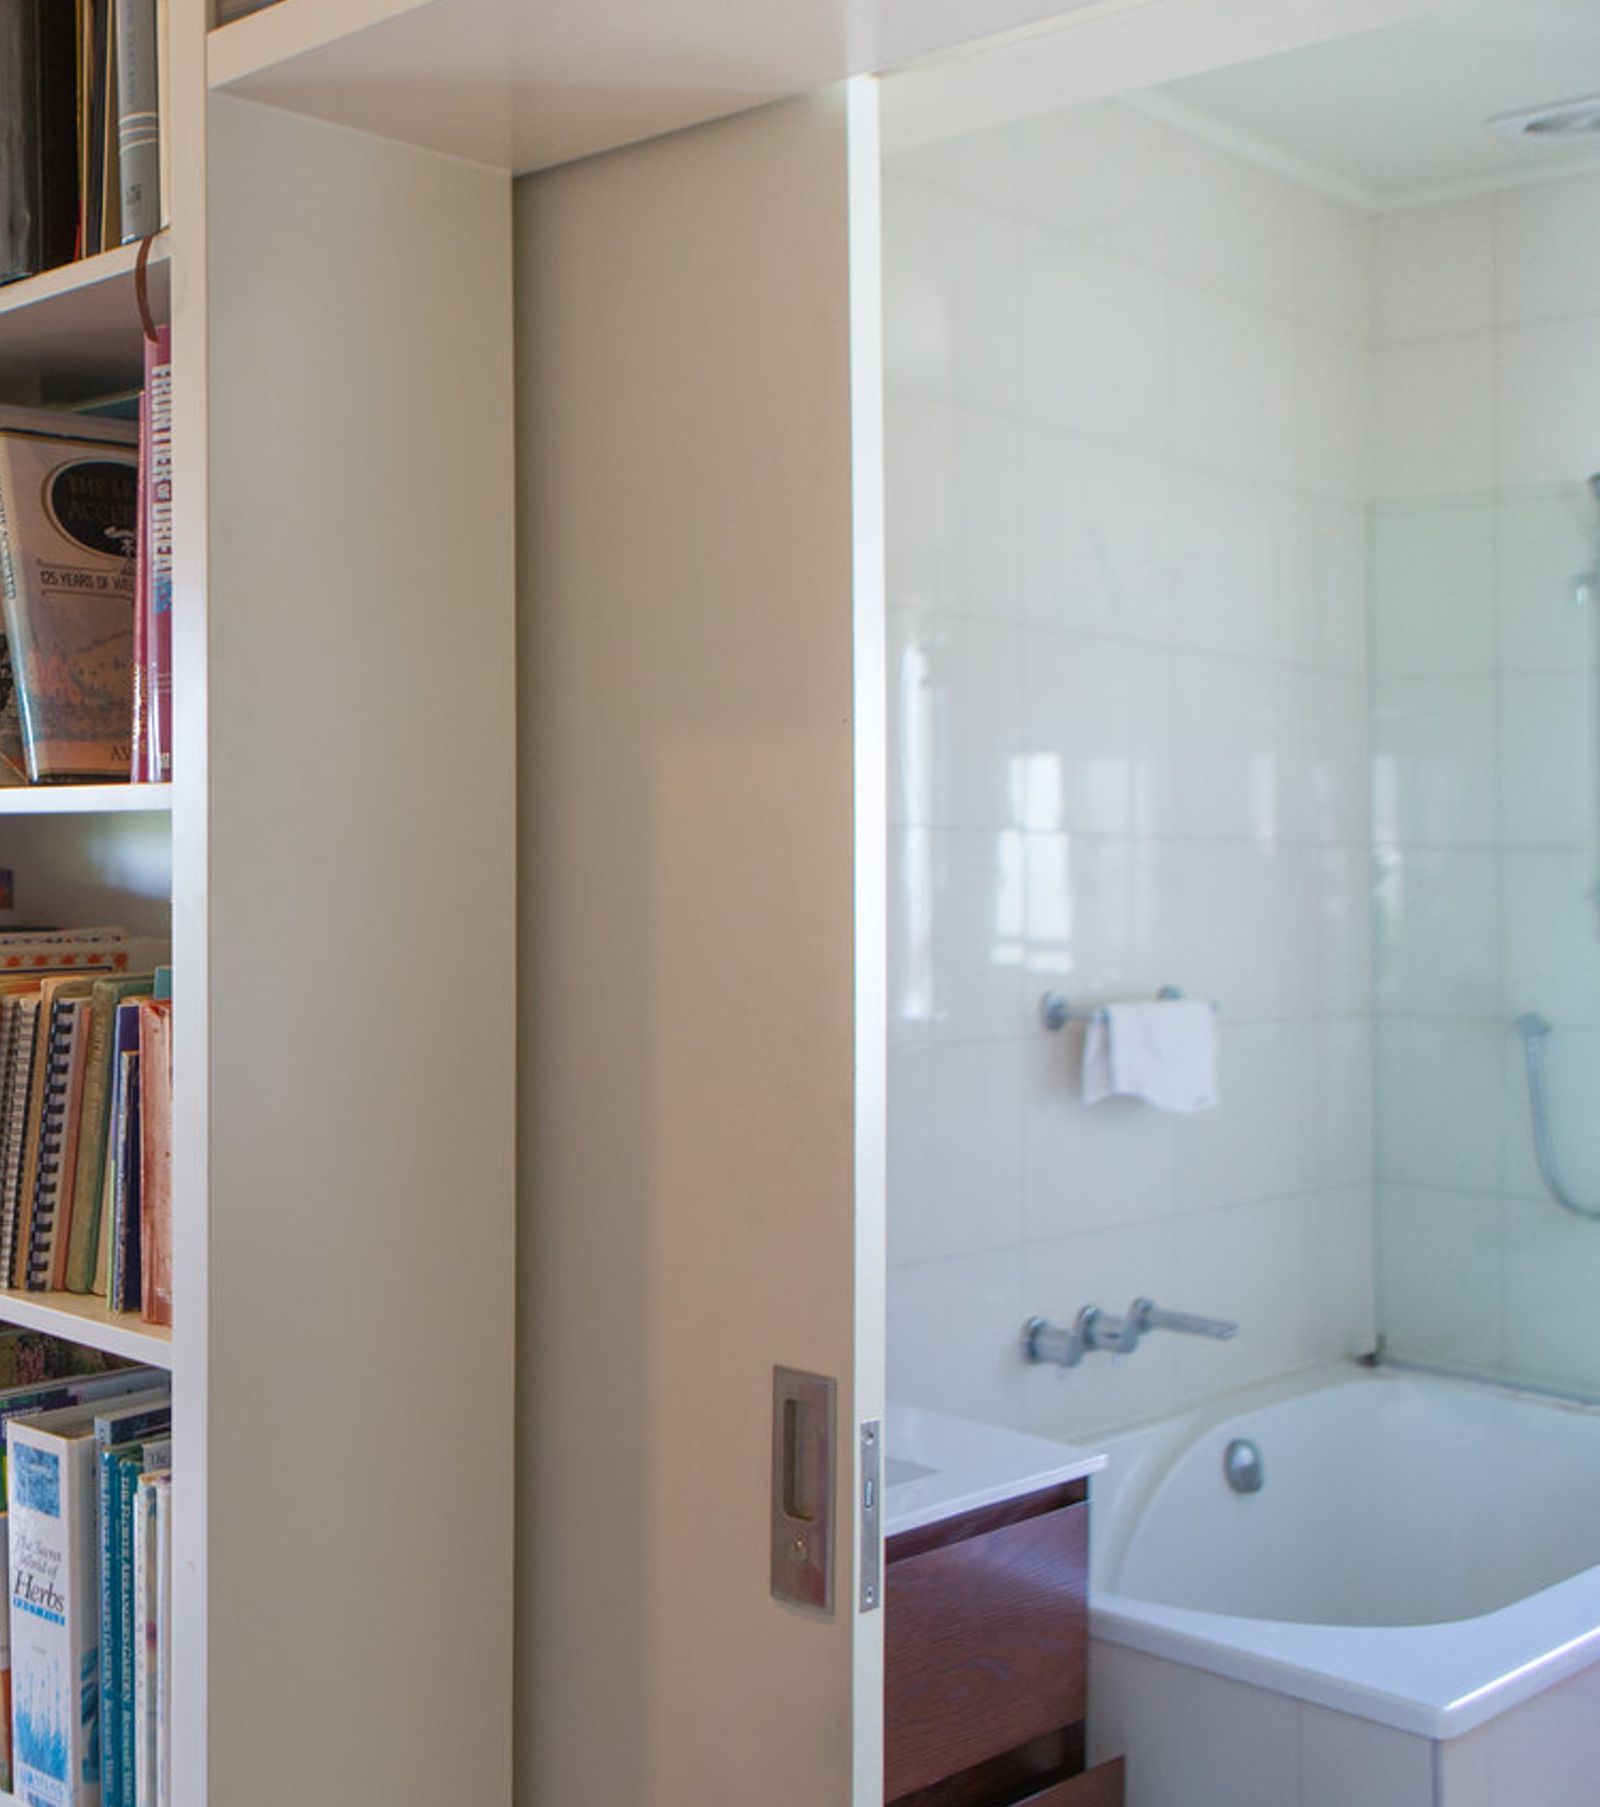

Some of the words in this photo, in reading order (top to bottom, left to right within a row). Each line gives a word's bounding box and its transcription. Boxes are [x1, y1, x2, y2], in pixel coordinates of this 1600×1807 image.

[60, 573, 95, 589] YEARS
[96, 575, 108, 589] OF
[112, 576, 135, 592] WEL
[14, 1570, 65, 1613] Herbs
